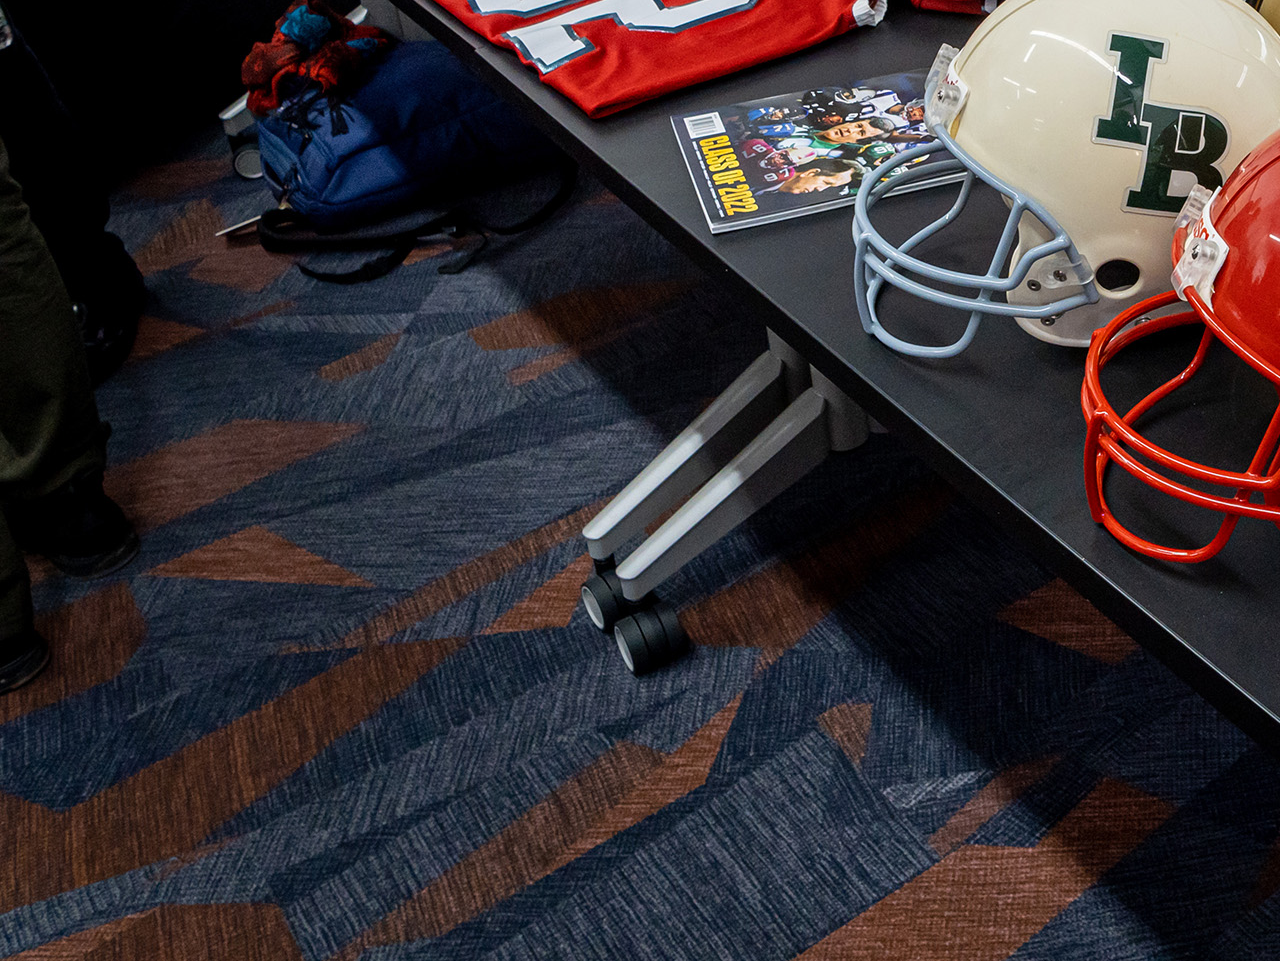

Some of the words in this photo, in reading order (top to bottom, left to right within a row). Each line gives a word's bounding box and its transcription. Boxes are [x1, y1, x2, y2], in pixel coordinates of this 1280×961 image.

[699, 135, 741, 172] CLASS
[712, 169, 747, 186] OF
[718, 184, 759, 216] 2022
